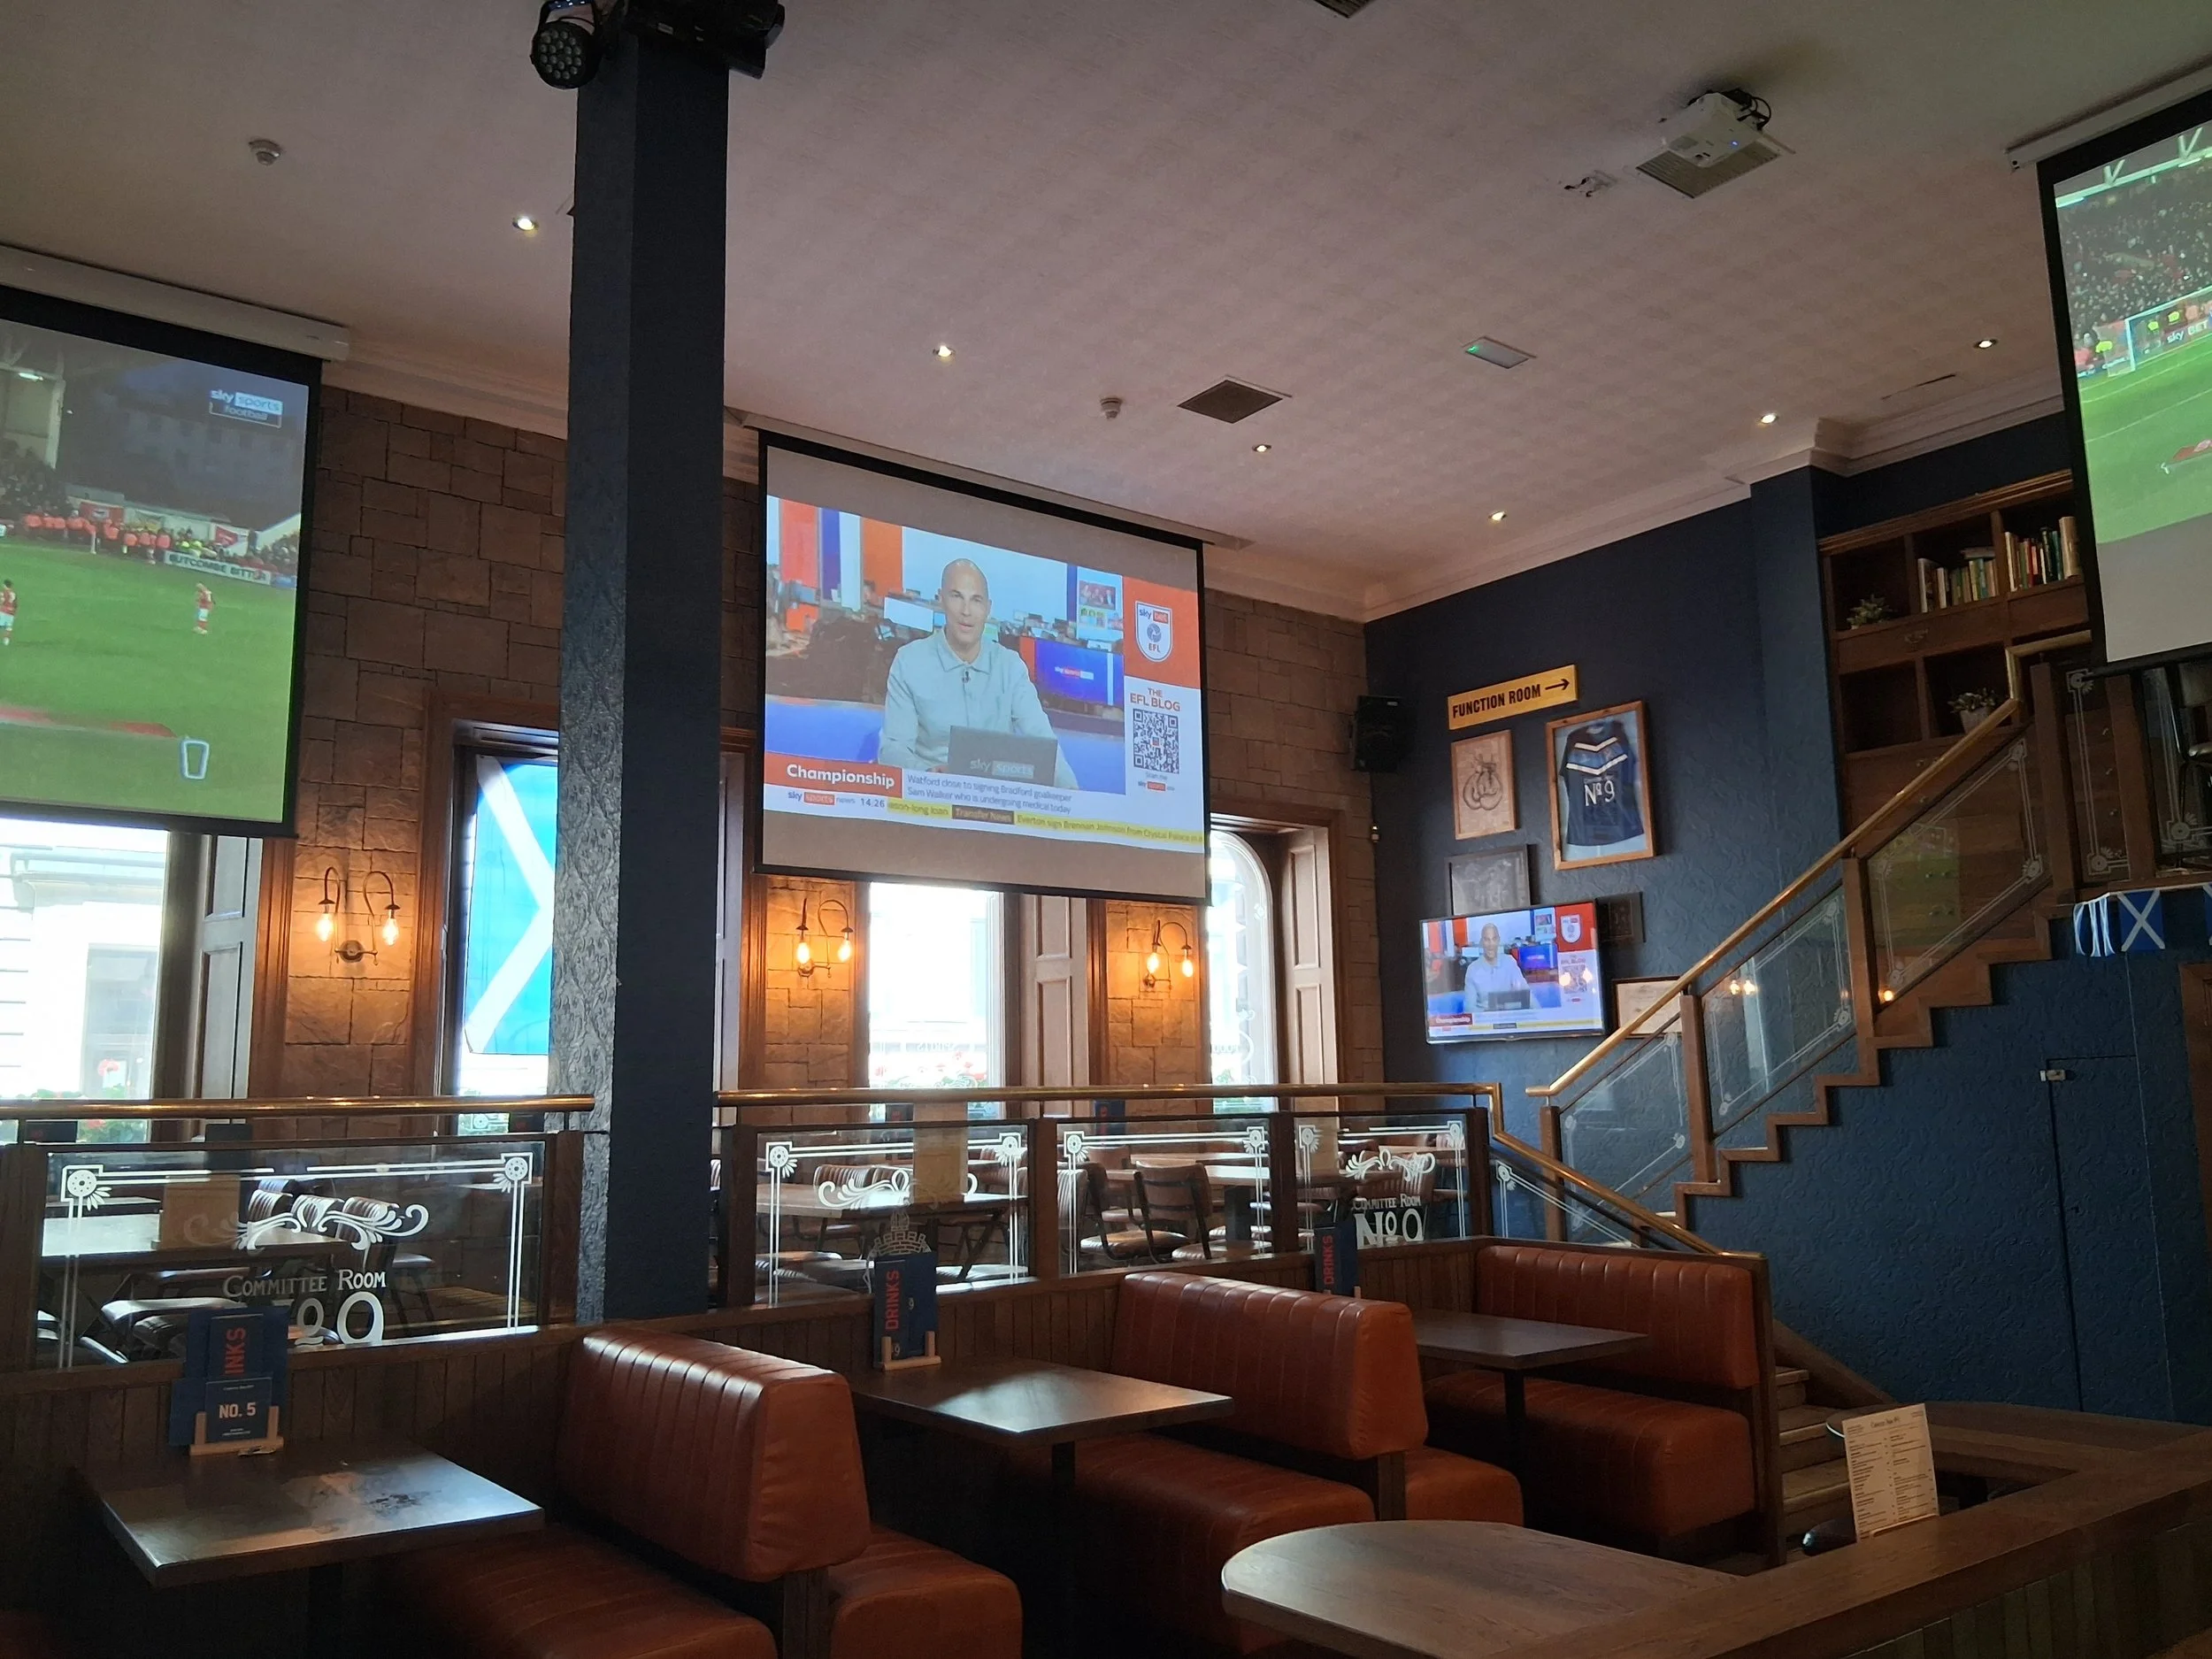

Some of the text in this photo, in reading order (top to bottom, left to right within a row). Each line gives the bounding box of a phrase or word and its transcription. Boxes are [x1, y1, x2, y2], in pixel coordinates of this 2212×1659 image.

[210, 388, 234, 403] sky
[1148, 642, 1161, 653] EFL
[1148, 687, 1163, 698] THE
[1452, 684, 1540, 719] FUNCTION ROOM
[1130, 693, 1181, 712] EFL BLOG
[970, 758, 991, 773] sky
[787, 764, 895, 789] Championship
[907, 774, 941, 787] Watford
[941, 779, 963, 790] close
[963, 781, 972, 790] to
[1000, 785, 1033, 797] Bradford
[787, 791, 803, 802] sky
[907, 787, 926, 797] Sam
[954, 792, 972, 802] who
[1604, 780, 1615, 803] 9
[1400, 1194, 1422, 1208] ROOM
[1323, 1235, 1334, 1286] DRINKS
[224, 1269, 387, 1298] COMMITTEE ROOM
[885, 1270, 900, 1331] DRINKS
[225, 1327, 246, 1375] INKS
[219, 1402, 257, 1419] NO. 5
